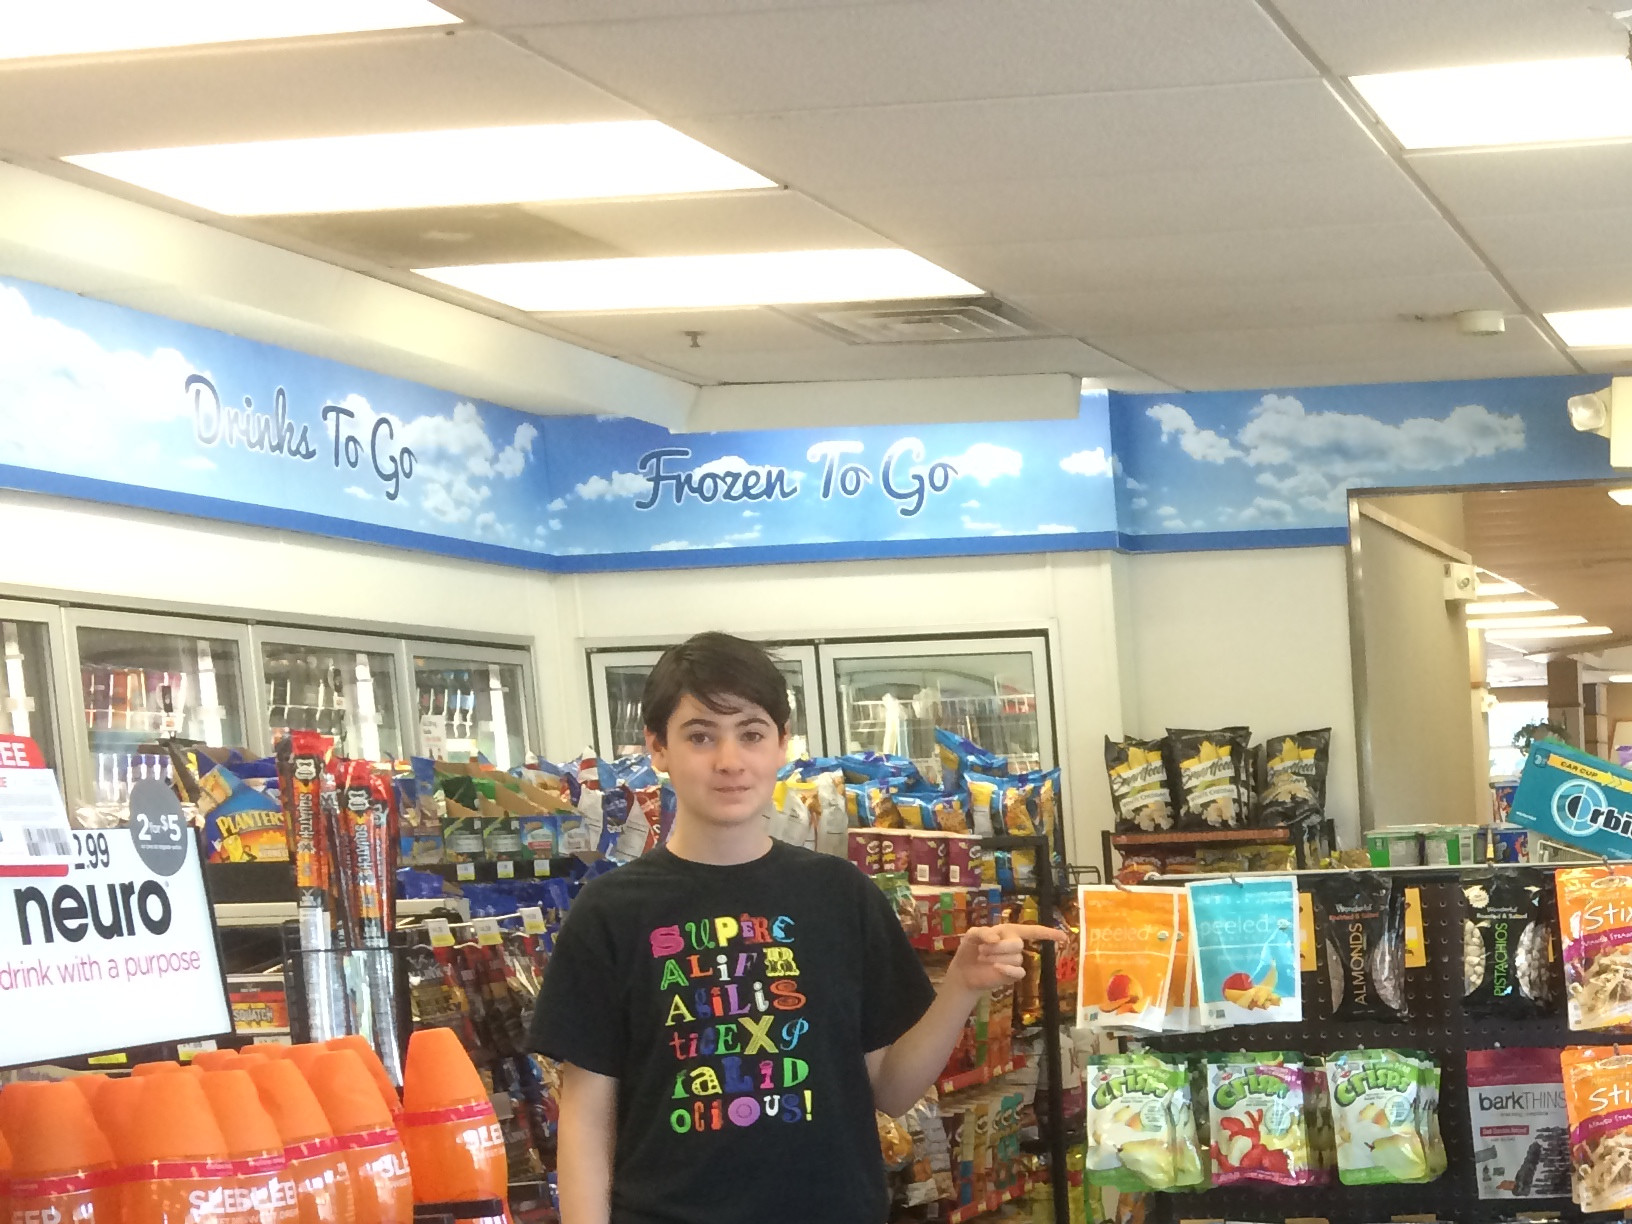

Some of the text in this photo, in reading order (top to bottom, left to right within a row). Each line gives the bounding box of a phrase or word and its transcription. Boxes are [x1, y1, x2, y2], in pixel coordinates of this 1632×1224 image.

[185, 374, 417, 500] Drinks To Go
[636, 437, 958, 516] Frozen To Go
[136, 813, 151, 840] 2
[13, 878, 172, 946] neuro
[1201, 916, 1271, 938] peeled
[0, 952, 201, 992] drink with a purpose
[1354, 922, 1368, 1006] ALMONDS
[1493, 922, 1508, 997] PISTACHIOS
[1478, 1090, 1568, 1112] barkTHINS
